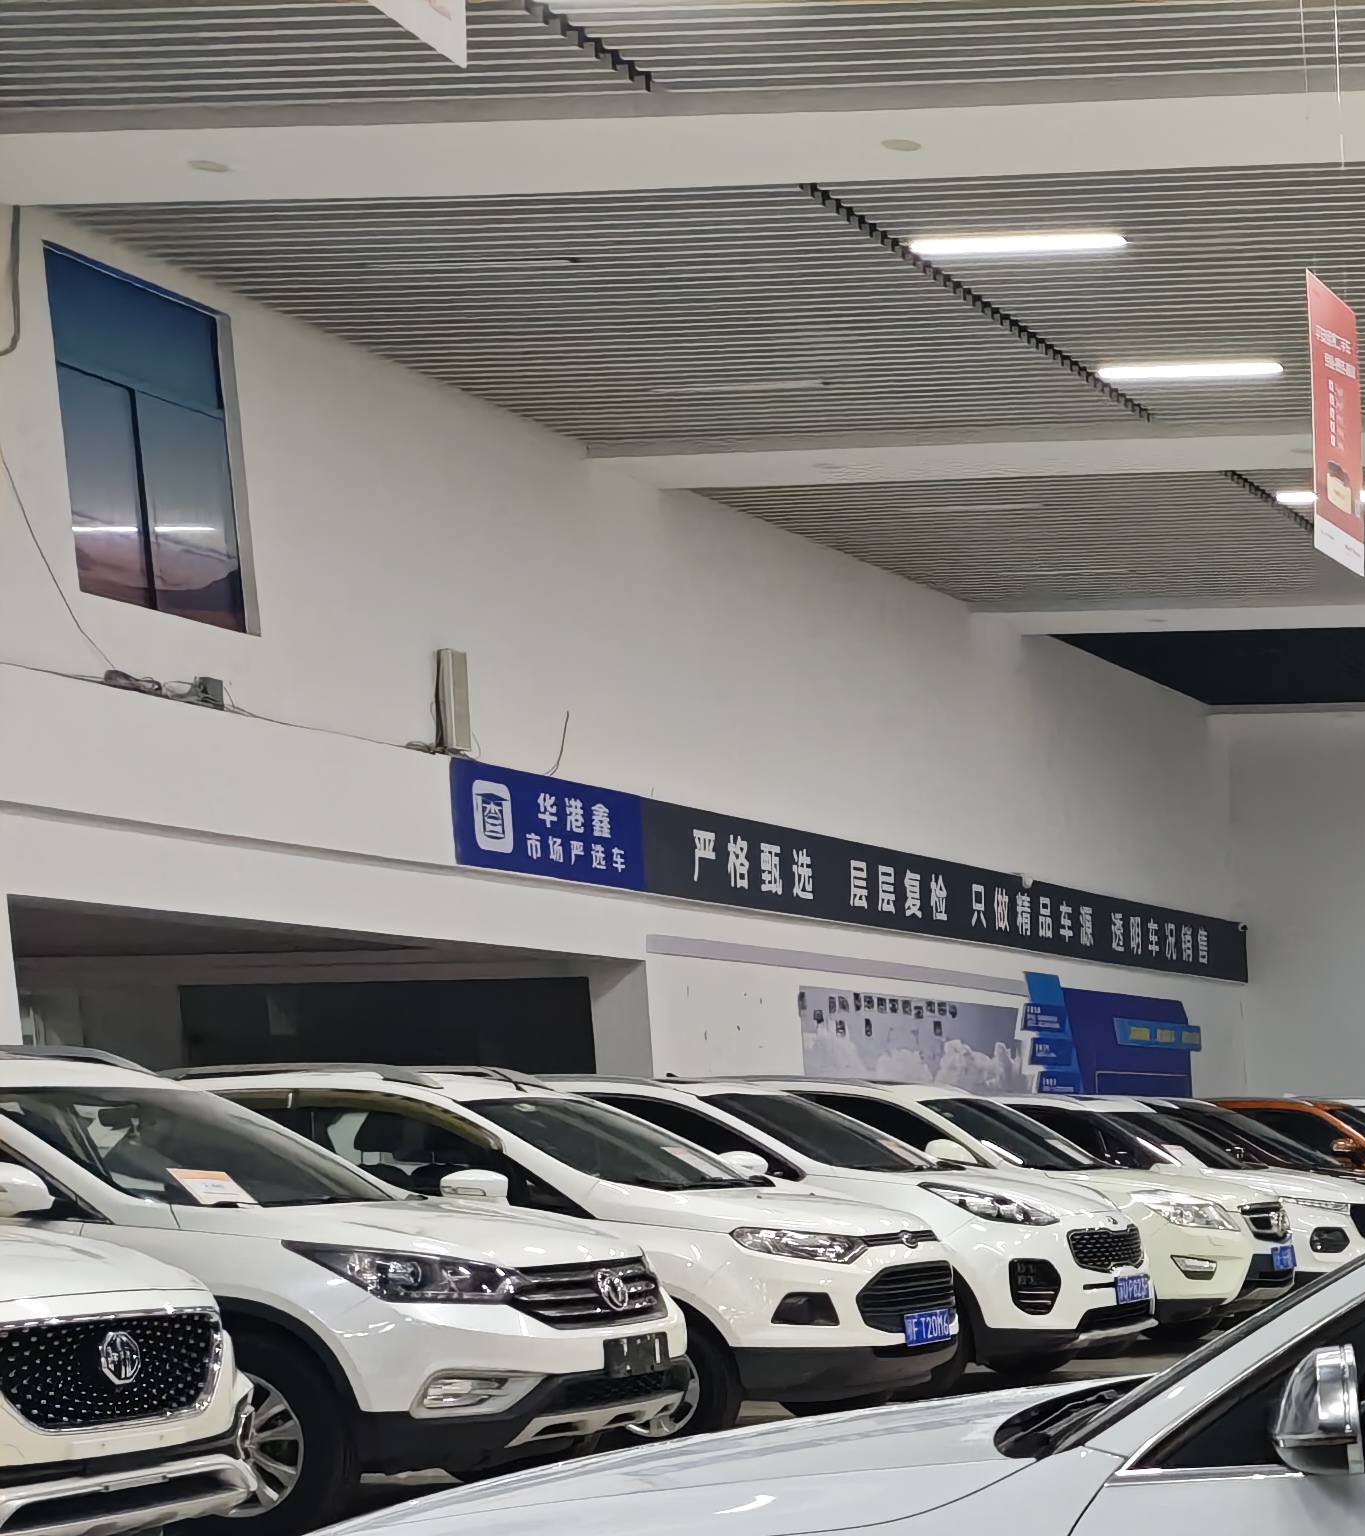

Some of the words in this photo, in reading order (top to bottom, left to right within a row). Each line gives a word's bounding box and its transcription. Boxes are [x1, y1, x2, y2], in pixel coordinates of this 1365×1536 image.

[536, 792, 612, 839] 华港鑫
[525, 832, 626, 873] 市场严选车
[692, 828, 814, 900] 严格甄选
[849, 859, 948, 921] 层层复检
[971, 883, 1095, 947] 只做精品车源
[1110, 911, 1209, 965] 透明车况销售
